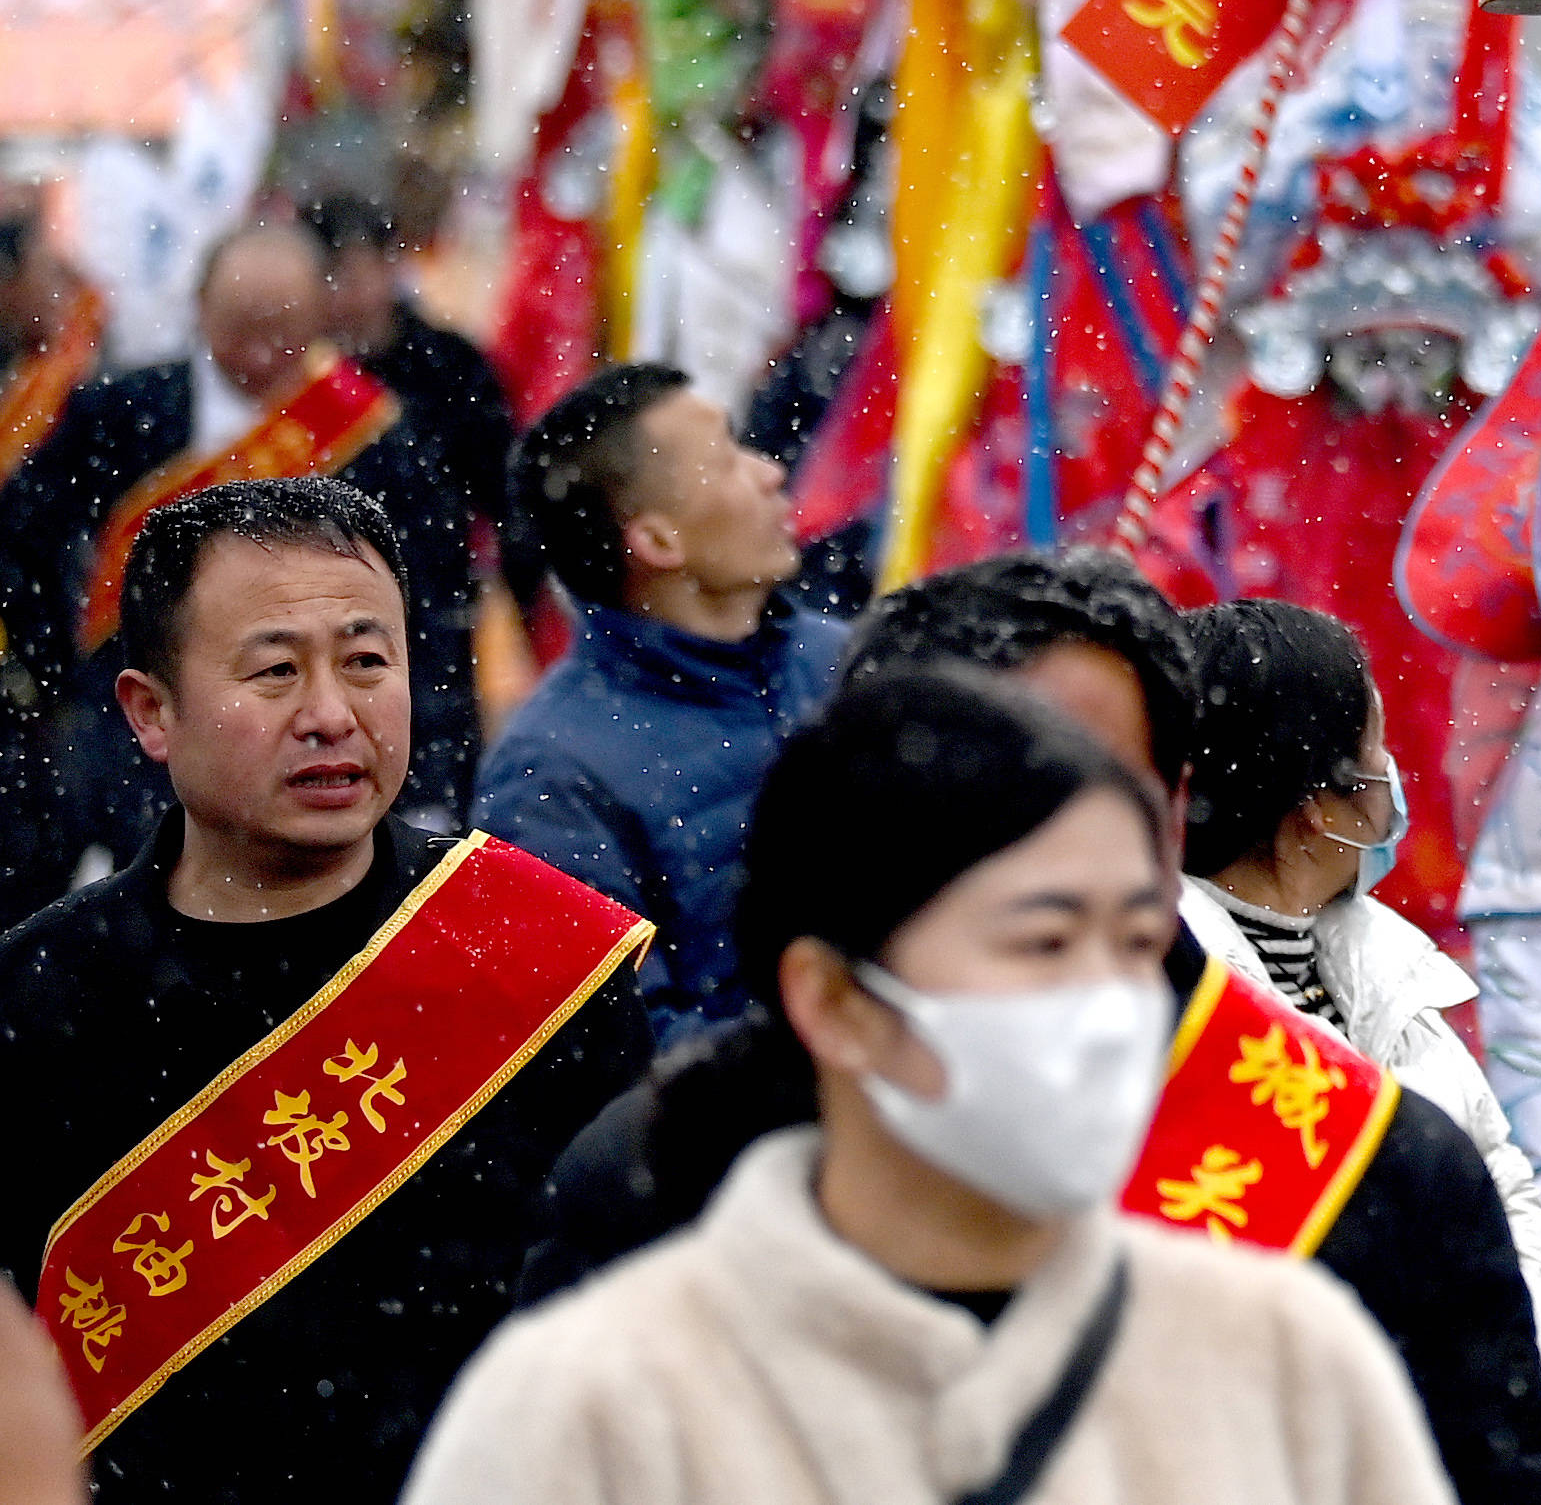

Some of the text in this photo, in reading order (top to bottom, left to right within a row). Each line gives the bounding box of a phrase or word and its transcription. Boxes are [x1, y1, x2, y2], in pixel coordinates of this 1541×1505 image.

[59, 1037, 409, 1374] 北坡村油桃
